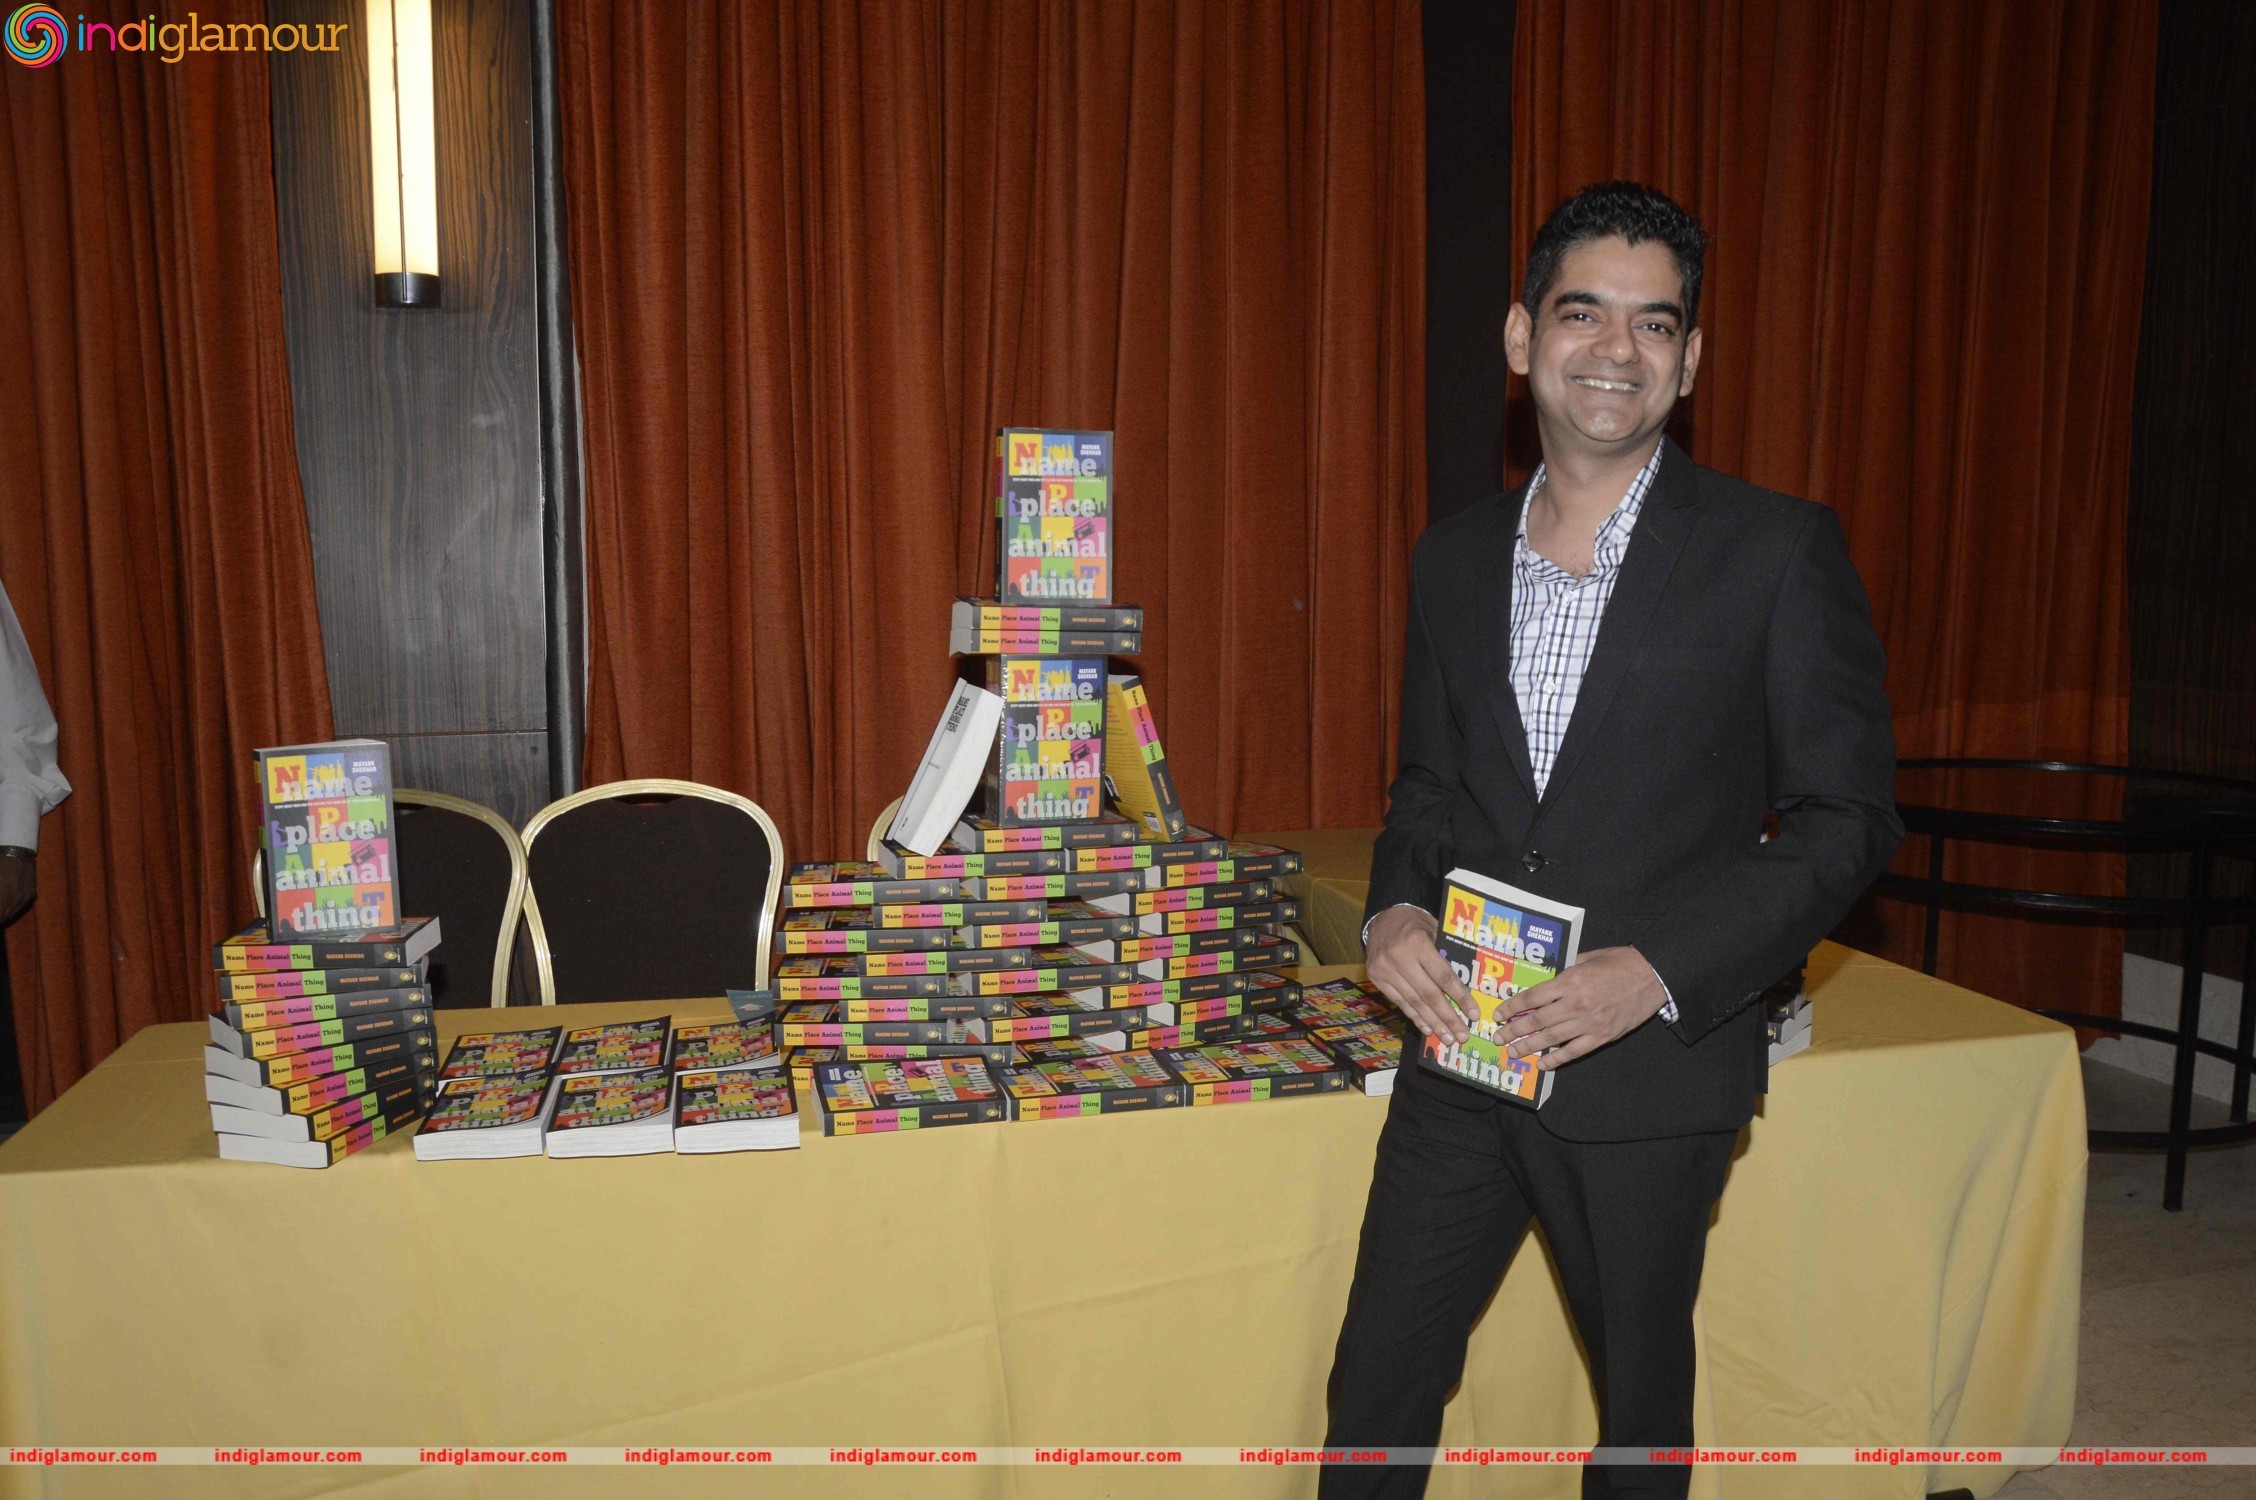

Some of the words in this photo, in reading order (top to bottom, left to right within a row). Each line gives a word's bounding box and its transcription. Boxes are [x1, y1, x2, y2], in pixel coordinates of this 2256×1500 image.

[1020, 456, 1097, 477] name
[1020, 489, 1096, 523] place
[1008, 531, 1106, 558] animal
[1019, 569, 1096, 599] thing
[1017, 681, 1093, 702] name
[1017, 715, 1092, 748] place
[1005, 752, 1101, 782] animal
[282, 775, 373, 802] name
[1016, 792, 1090, 820] thing
[285, 815, 375, 853] place
[1113, 853, 1132, 861] Animal
[275, 854, 391, 891] animal
[291, 900, 380, 932] thing
[847, 938, 865, 946] Thing
[1455, 915, 1546, 965] name
[1527, 931, 1554, 943] SHEKHAR
[1529, 925, 1553, 937] MAYANK
[277, 980, 302, 988] Animal
[1450, 959, 1530, 1000] plac
[266, 1008, 285, 1017] Place
[287, 1006, 312, 1014] Animal
[314, 1004, 334, 1012] Thing
[909, 1006, 927, 1014] Thing
[255, 1039, 275, 1047] Name
[276, 1035, 294, 1044] Place
[296, 1032, 320, 1041] Animal
[322, 1030, 342, 1038] Thing
[844, 1031, 862, 1039] Thing
[272, 1066, 290, 1075] Name
[291, 1061, 308, 1071] Place
[310, 1056, 332, 1067] Animal
[334, 1053, 353, 1062] Thing
[1437, 1042, 1524, 1096] thing
[292, 1091, 308, 1100] Name
[309, 1086, 324, 1096] Place
[326, 1080, 346, 1092] Animal
[347, 1077, 364, 1086] Thing
[1230, 1087, 1251, 1095] Animal
[1058, 1102, 1080, 1110] Animal
[856, 1118, 873, 1126] Place
[875, 1116, 898, 1124] Animal
